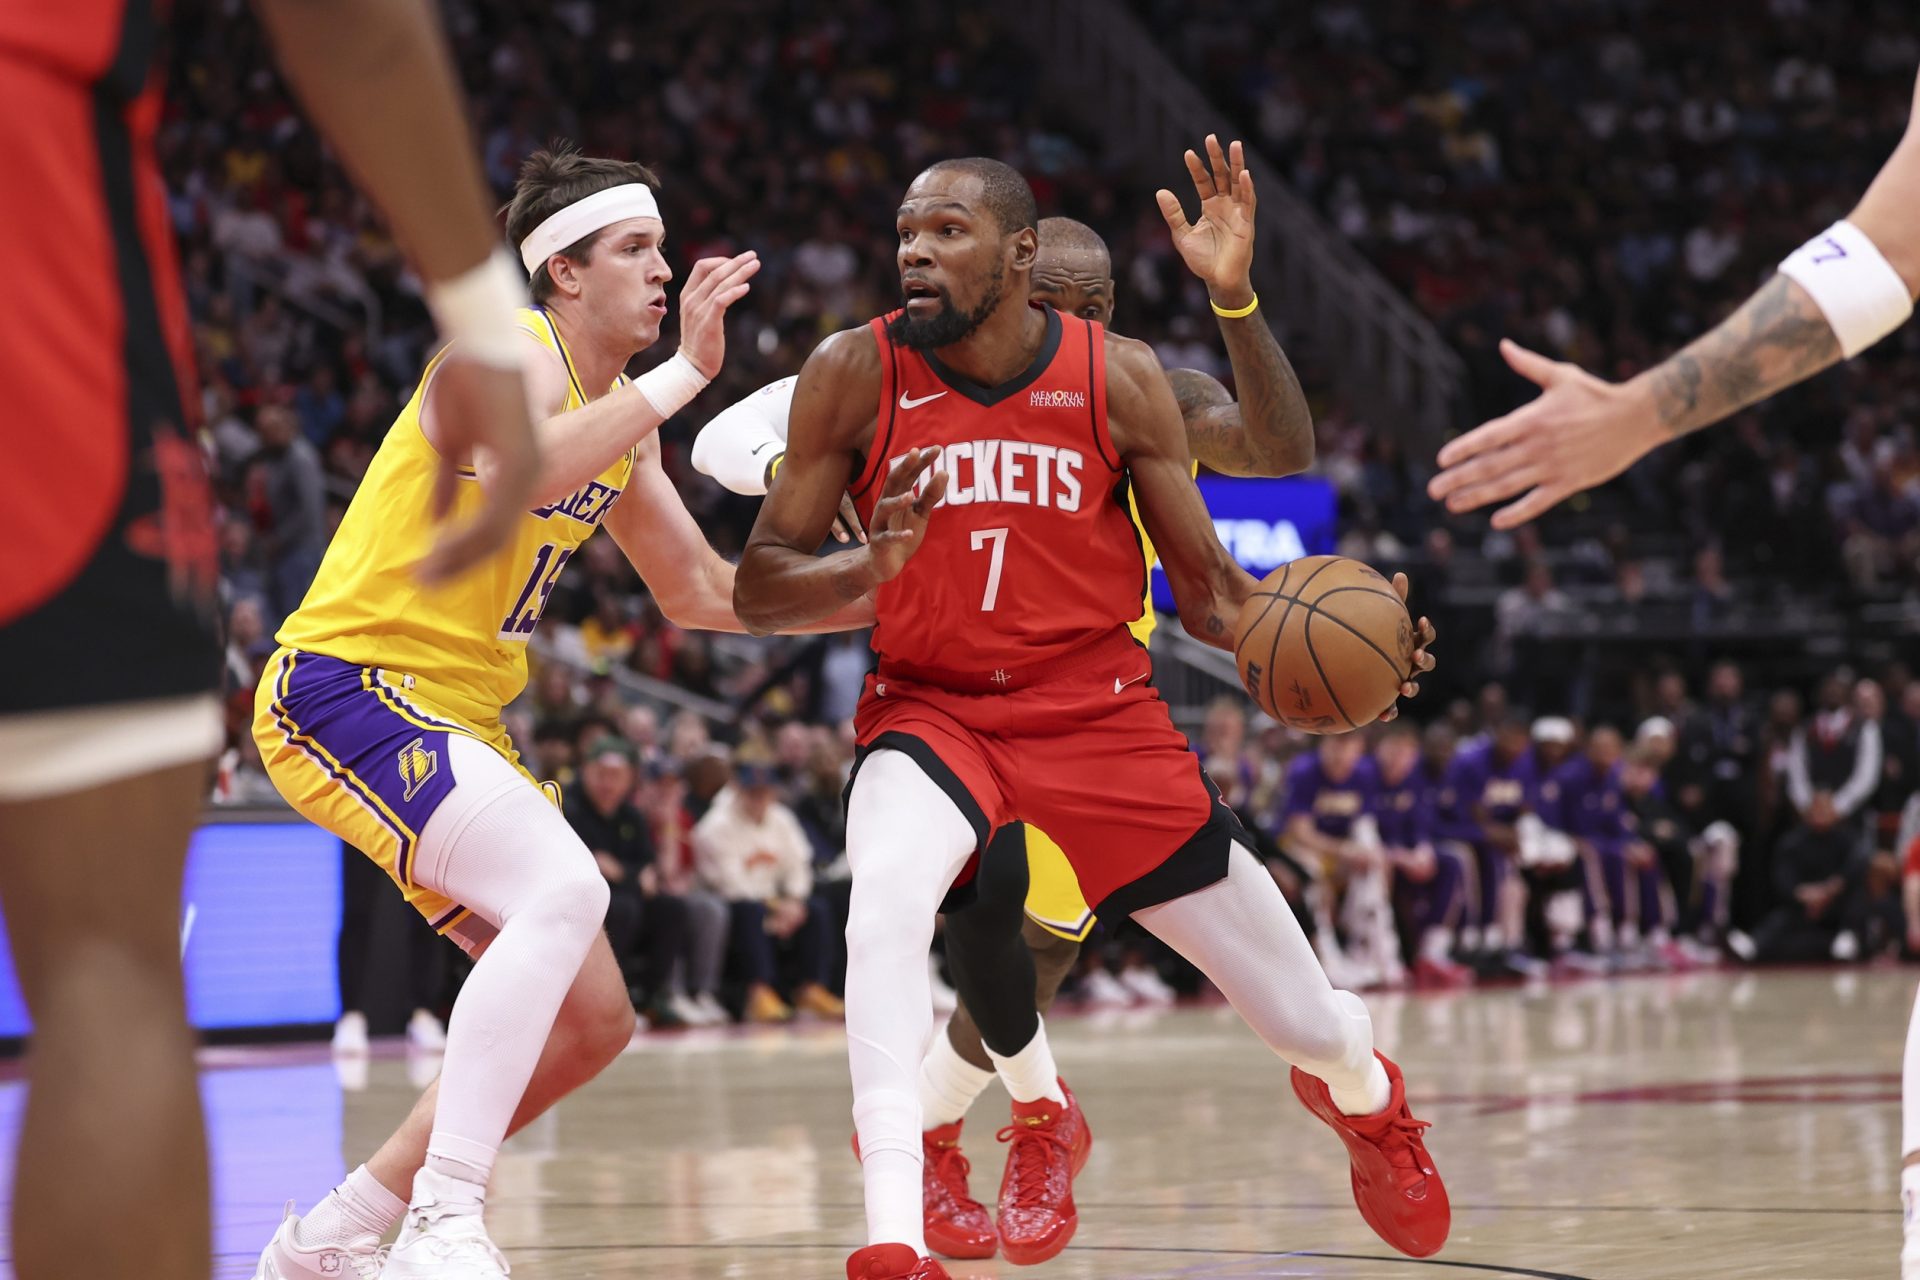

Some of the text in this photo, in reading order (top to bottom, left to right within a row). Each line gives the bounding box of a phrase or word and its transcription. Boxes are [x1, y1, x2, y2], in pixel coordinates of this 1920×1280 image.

[1030, 390, 1085, 400] MEMORIAL
[1030, 399, 1085, 407] HERMANN
[889, 438, 1084, 513] CKETS
[497, 542, 576, 641] 15
[970, 527, 1009, 612] 7
